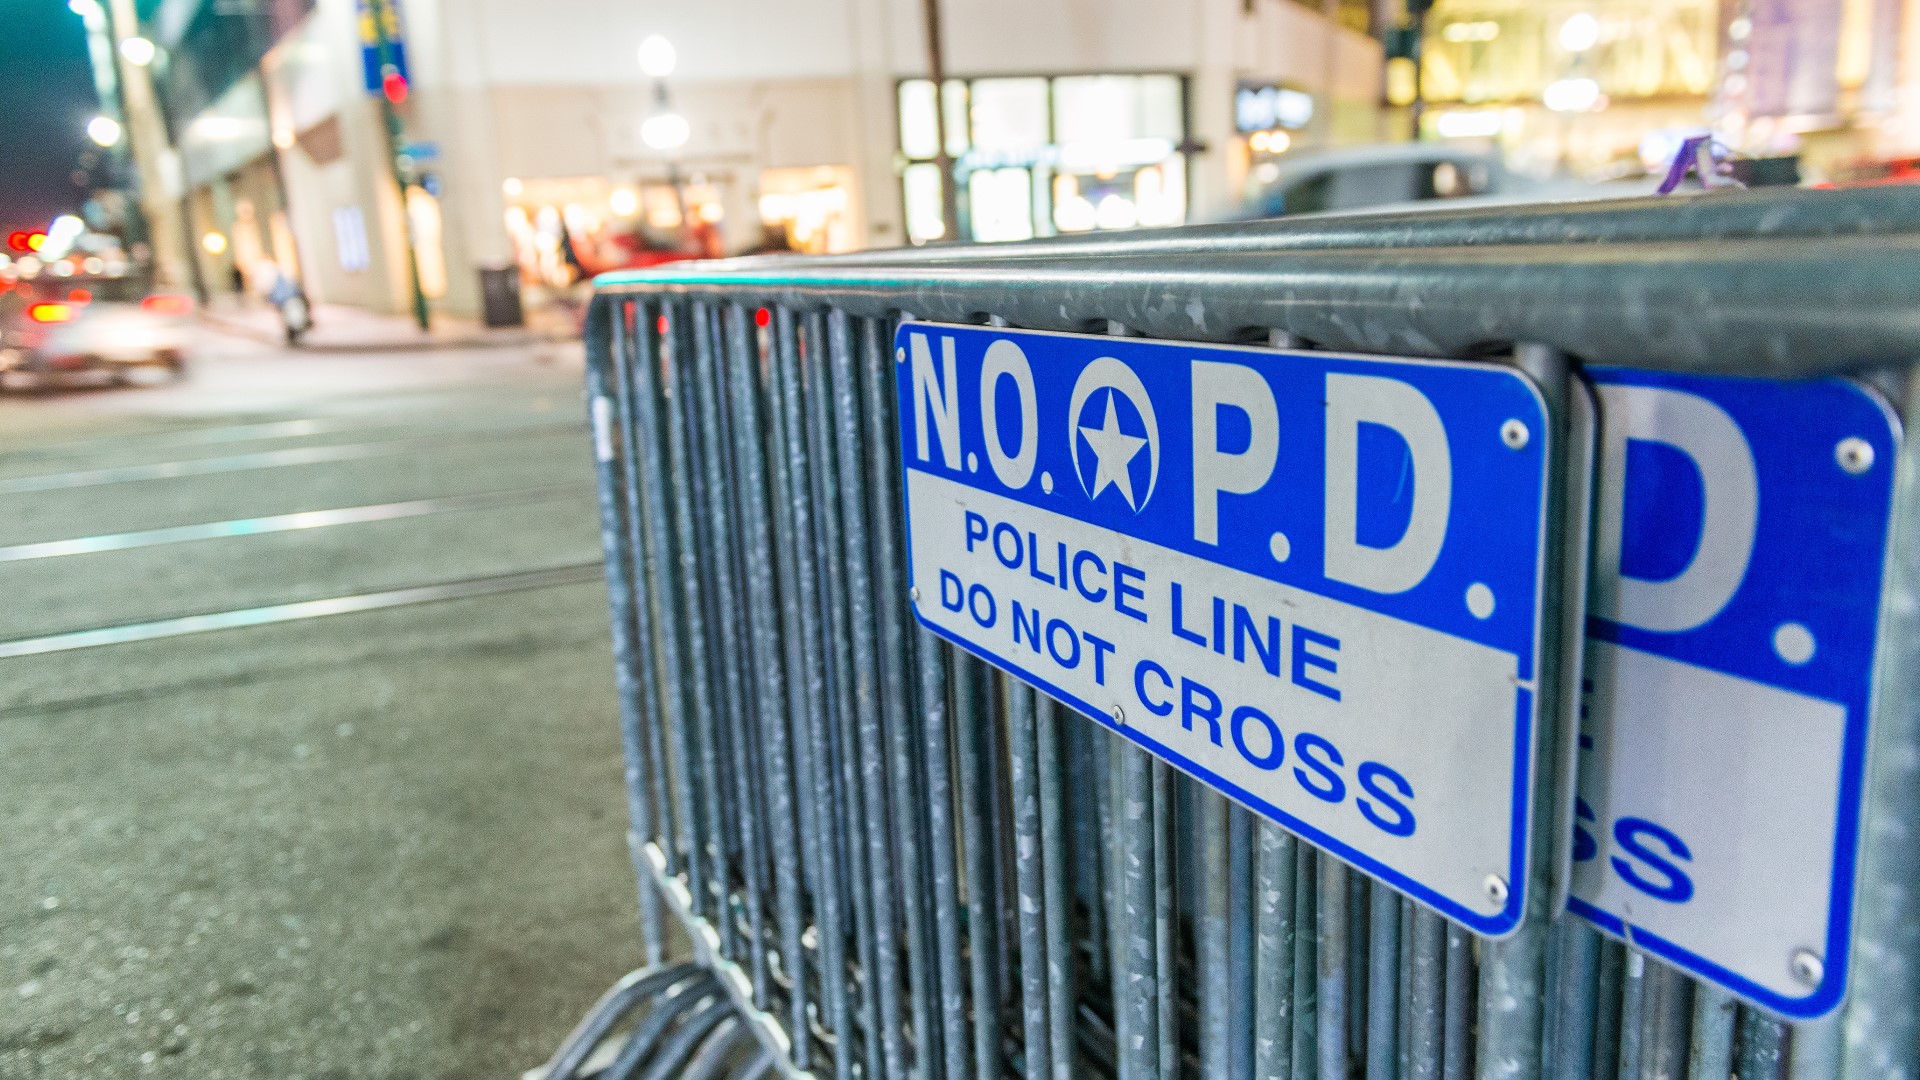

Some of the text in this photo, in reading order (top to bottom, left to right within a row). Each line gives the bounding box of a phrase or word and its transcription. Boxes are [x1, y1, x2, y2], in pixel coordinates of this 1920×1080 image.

[939, 568, 1418, 838] DO NOT CROSS
[964, 510, 1342, 702] POLICE LINE
